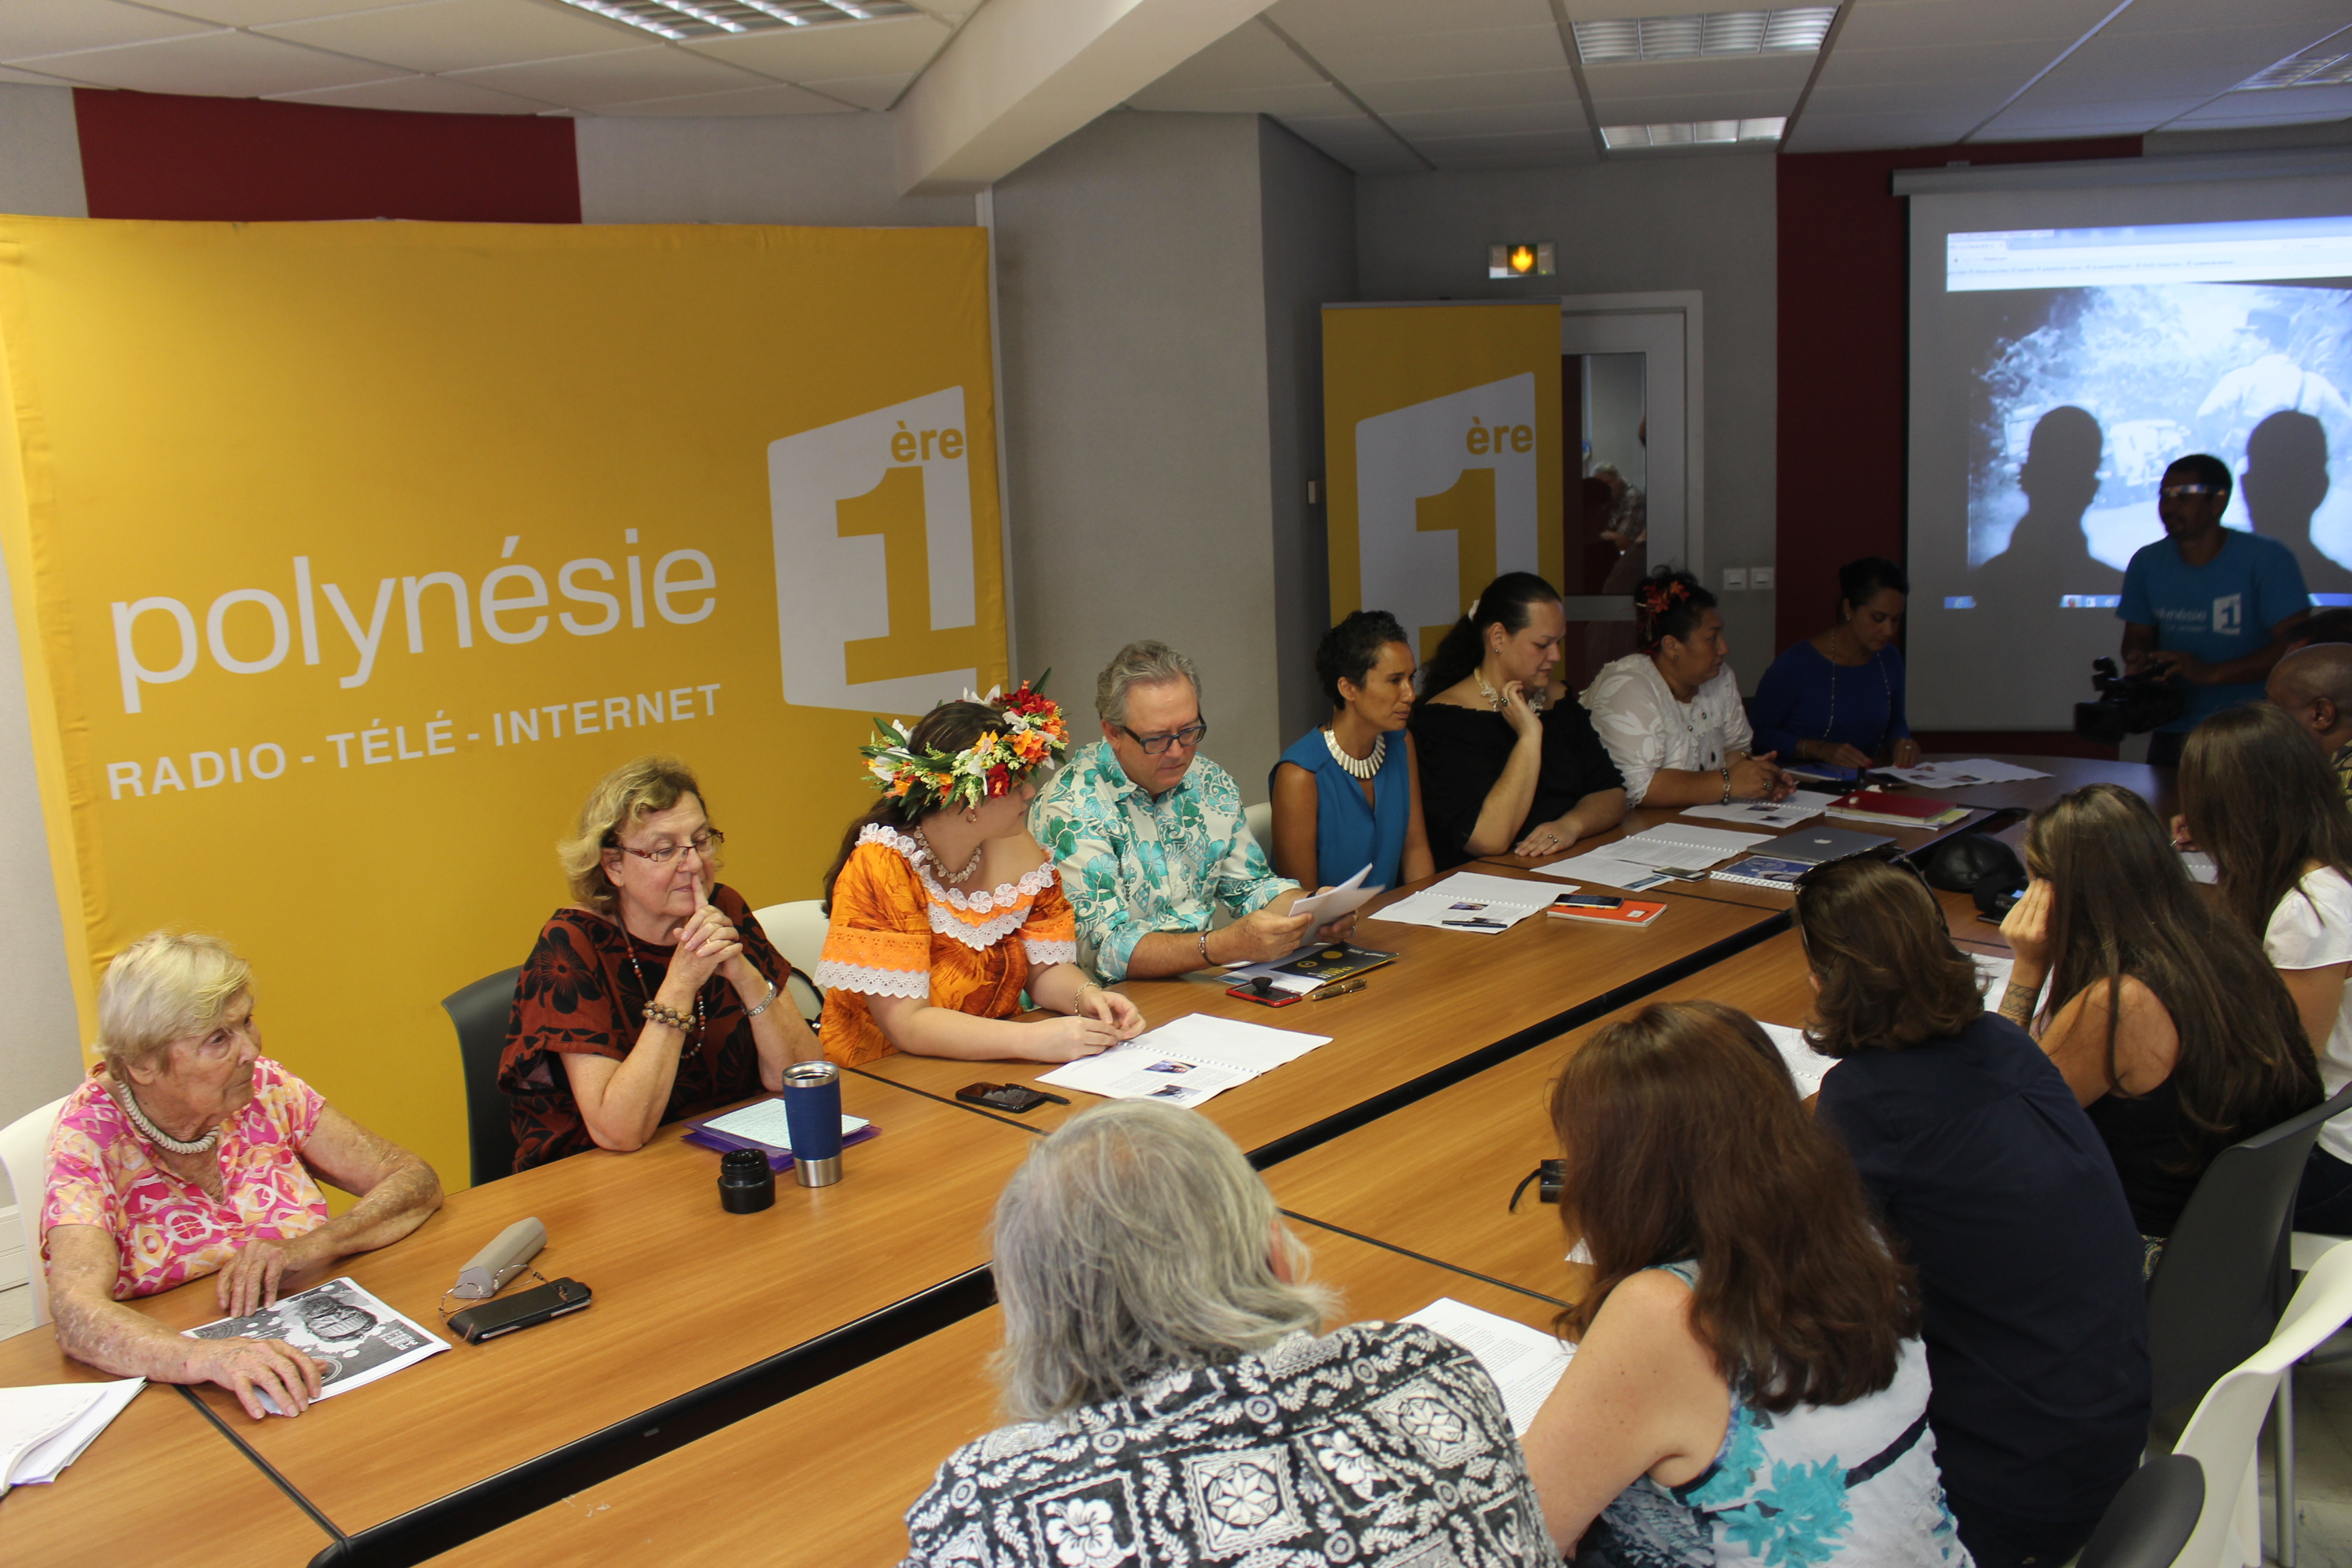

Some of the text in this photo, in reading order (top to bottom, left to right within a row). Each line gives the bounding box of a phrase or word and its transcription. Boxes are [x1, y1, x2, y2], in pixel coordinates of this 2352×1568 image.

[890, 420, 964, 463] ère
[1466, 417, 1534, 455] ère
[111, 528, 717, 714] polynésie
[835, 465, 977, 685] 1
[1415, 467, 1498, 668] 1
[106, 742, 287, 800] RADIO
[325, 710, 456, 768] TÉLÉ
[493, 683, 721, 747] INTERNET
